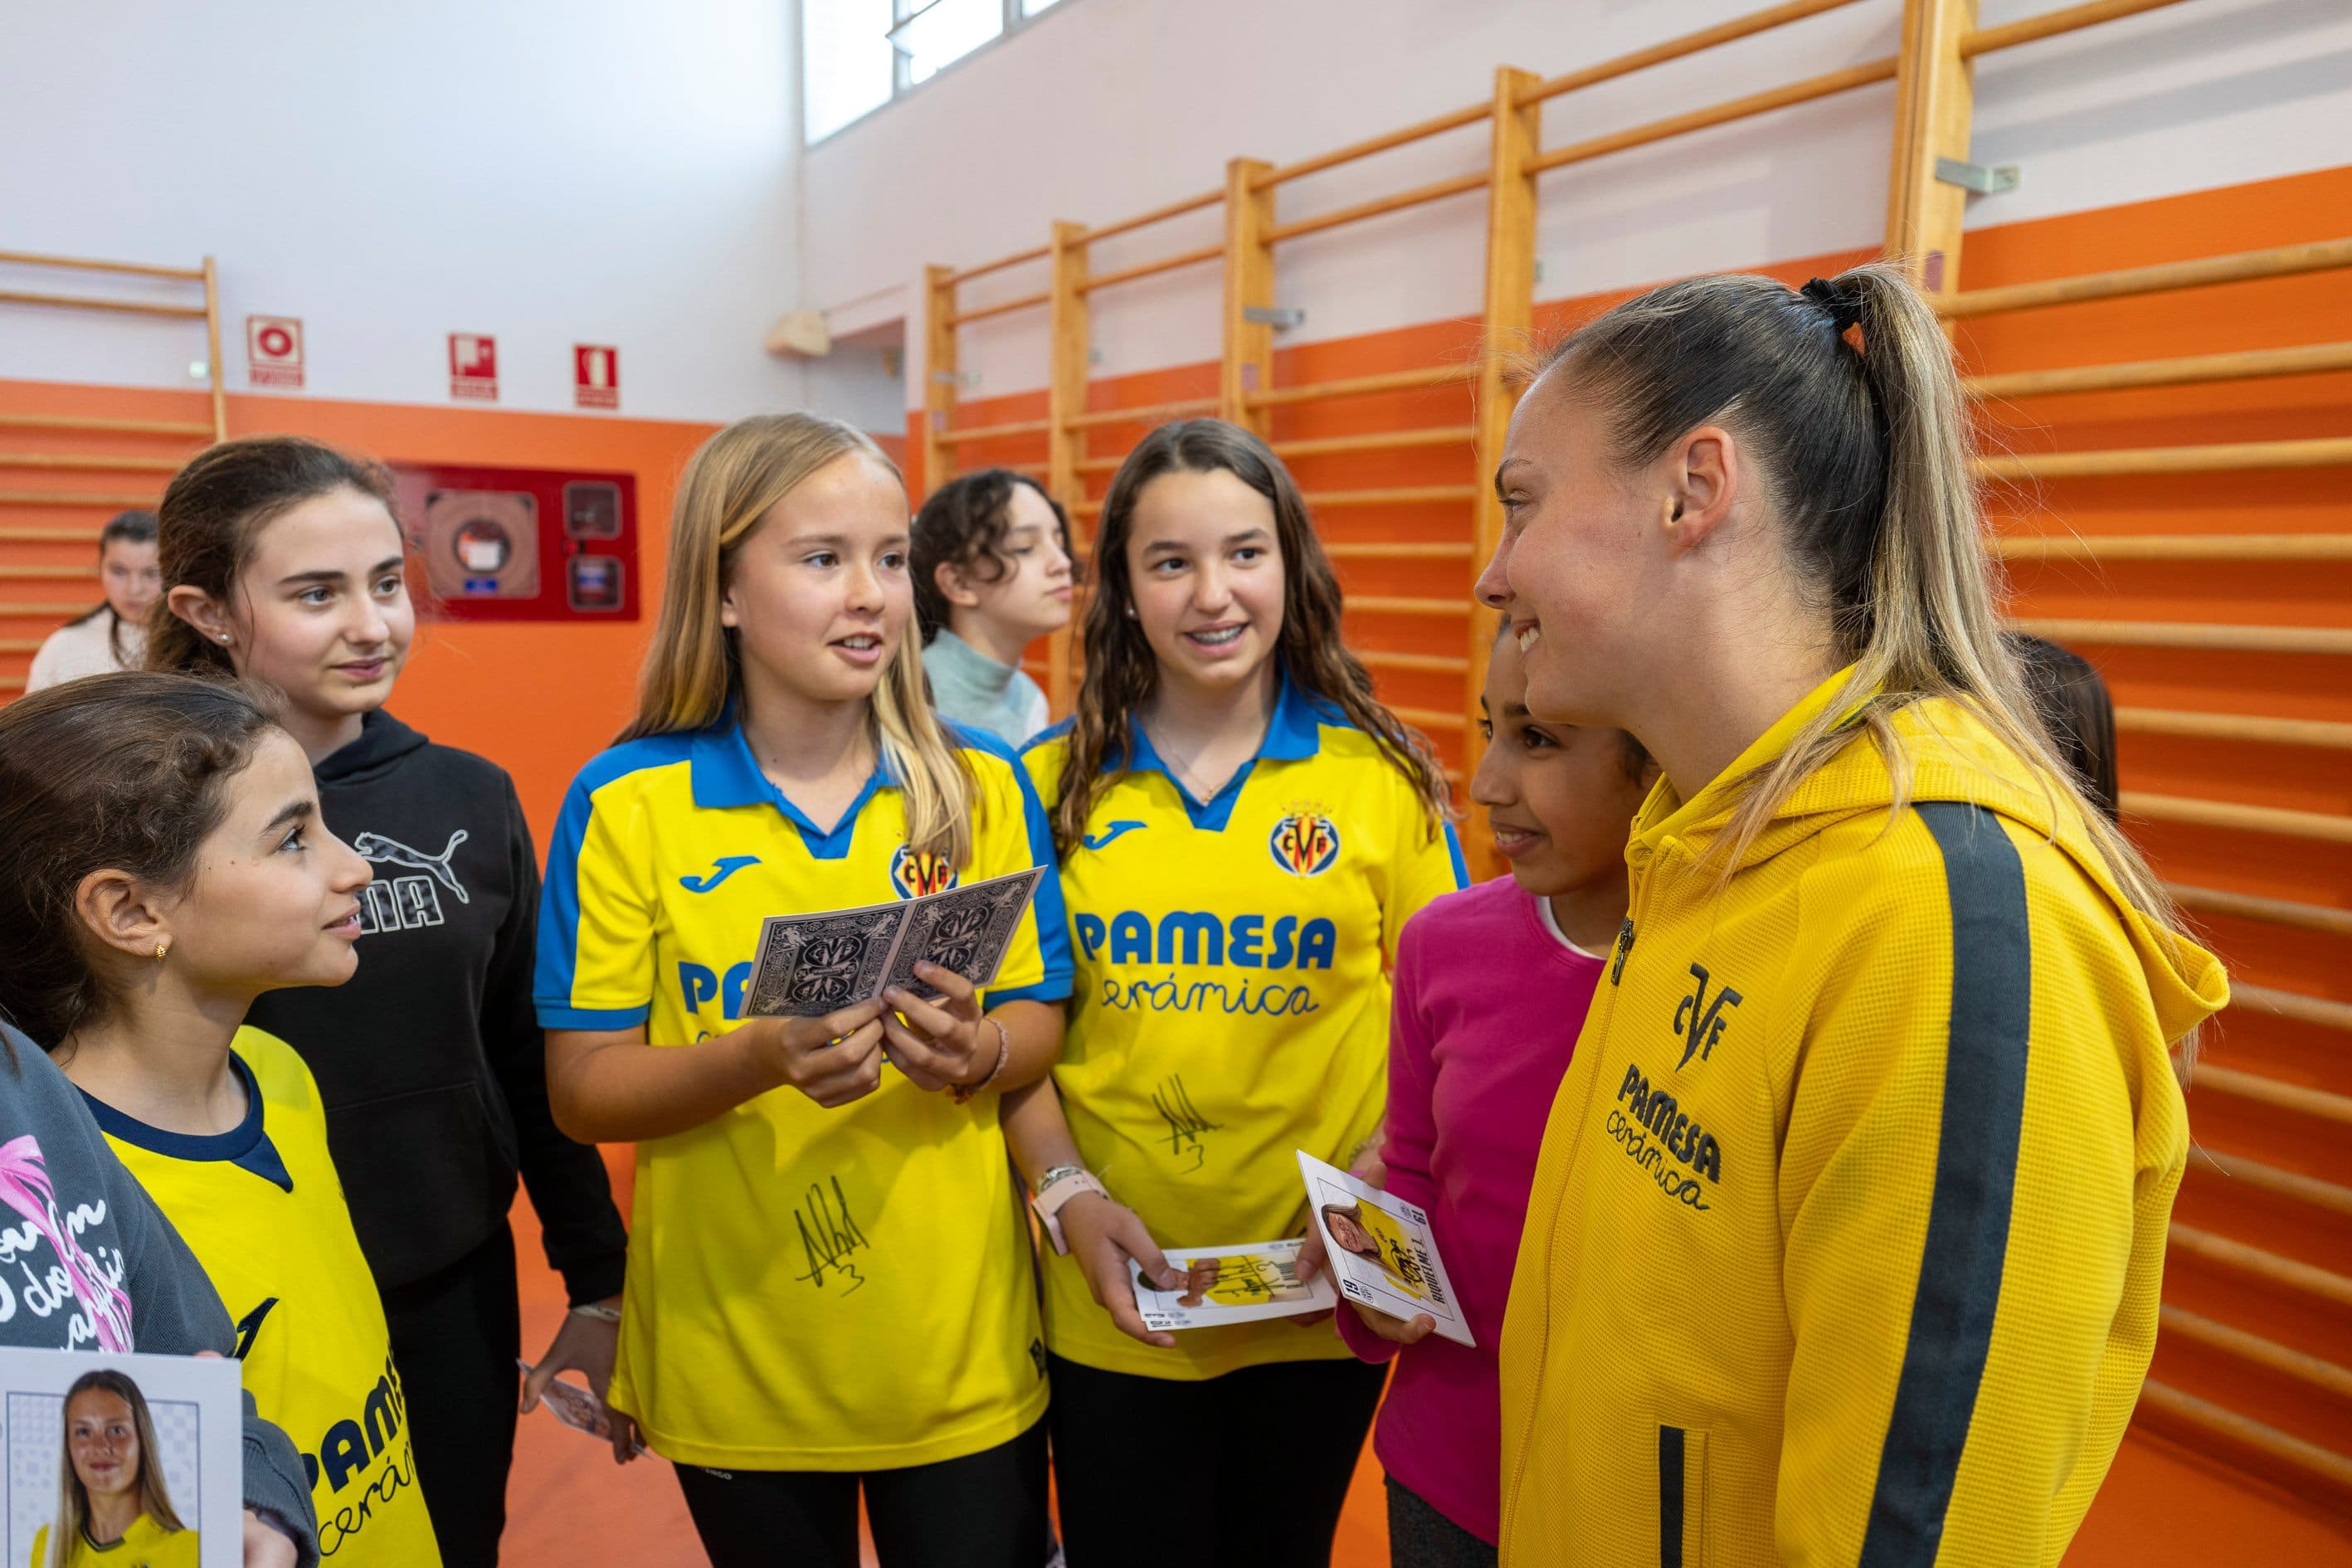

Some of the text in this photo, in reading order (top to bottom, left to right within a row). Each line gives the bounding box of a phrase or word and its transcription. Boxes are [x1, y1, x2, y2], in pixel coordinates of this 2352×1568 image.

[1074, 910, 1337, 970] PAMESA
[1102, 972, 1321, 1016] erámica
[1618, 1063, 1721, 1185] PAMESA
[1606, 1109, 1711, 1210] cerámica
[1342, 1278, 1361, 1296] 19
[1414, 1246, 1446, 1305] RIQUELME
[318, 1440, 415, 1557] cerá
